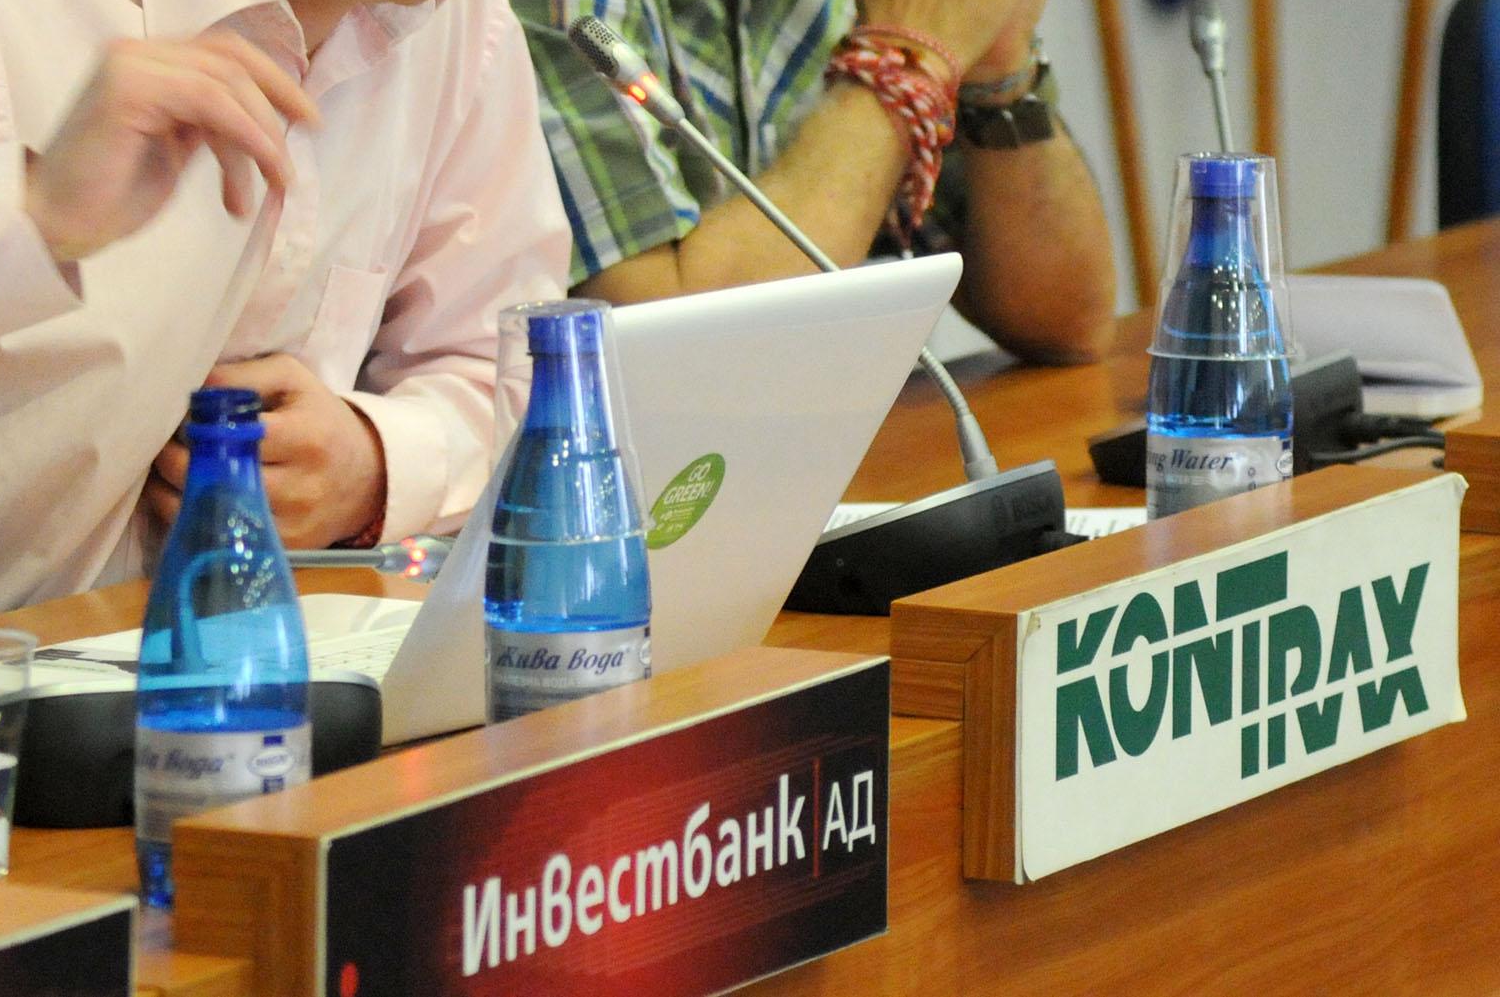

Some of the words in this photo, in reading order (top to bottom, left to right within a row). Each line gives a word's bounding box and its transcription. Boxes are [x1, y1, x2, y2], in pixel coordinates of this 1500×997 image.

[1170, 449, 1232, 471] Water
[688, 462, 712, 482] GO
[822, 770, 876, 852] АД
